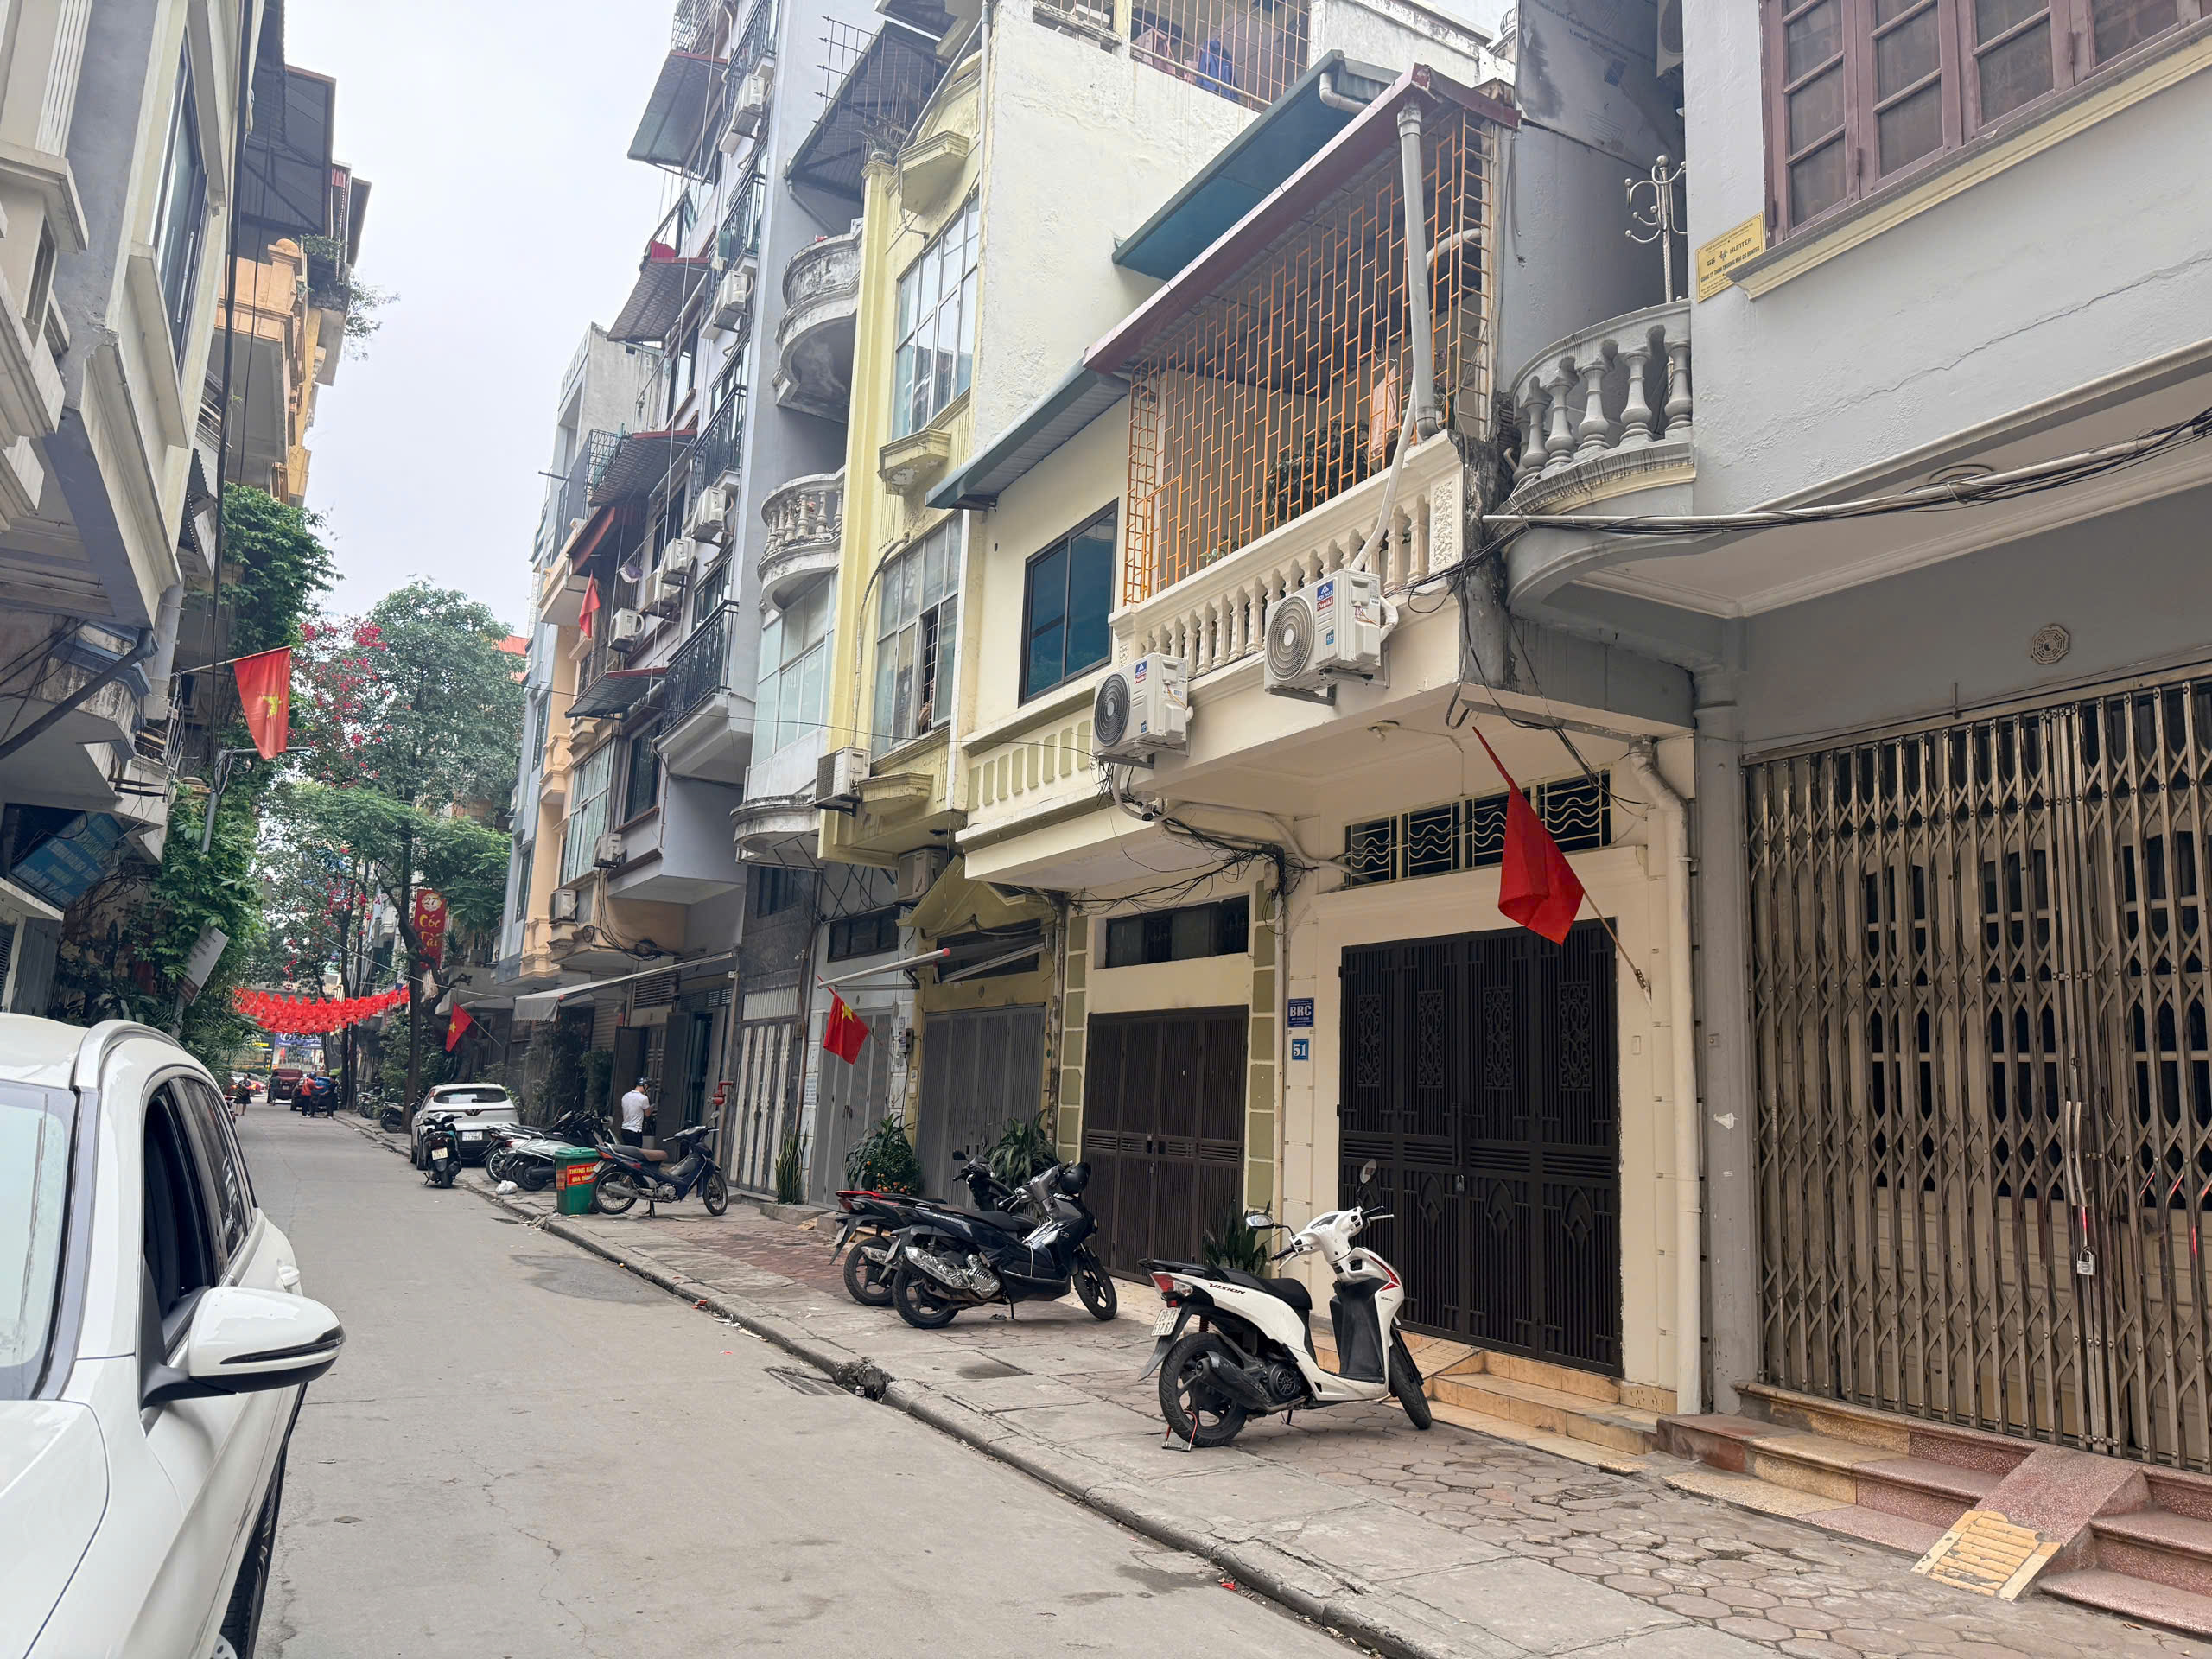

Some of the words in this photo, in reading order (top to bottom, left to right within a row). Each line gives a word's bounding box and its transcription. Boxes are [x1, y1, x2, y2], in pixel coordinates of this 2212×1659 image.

[1707, 257, 1715, 266] GG
[1730, 237, 1752, 254] HUNTER
[419, 913, 441, 927] Cóc
[1289, 1005, 1312, 1017] BRC
[1293, 1043, 1306, 1057] 51
[1209, 1282, 1246, 1294] VISION
